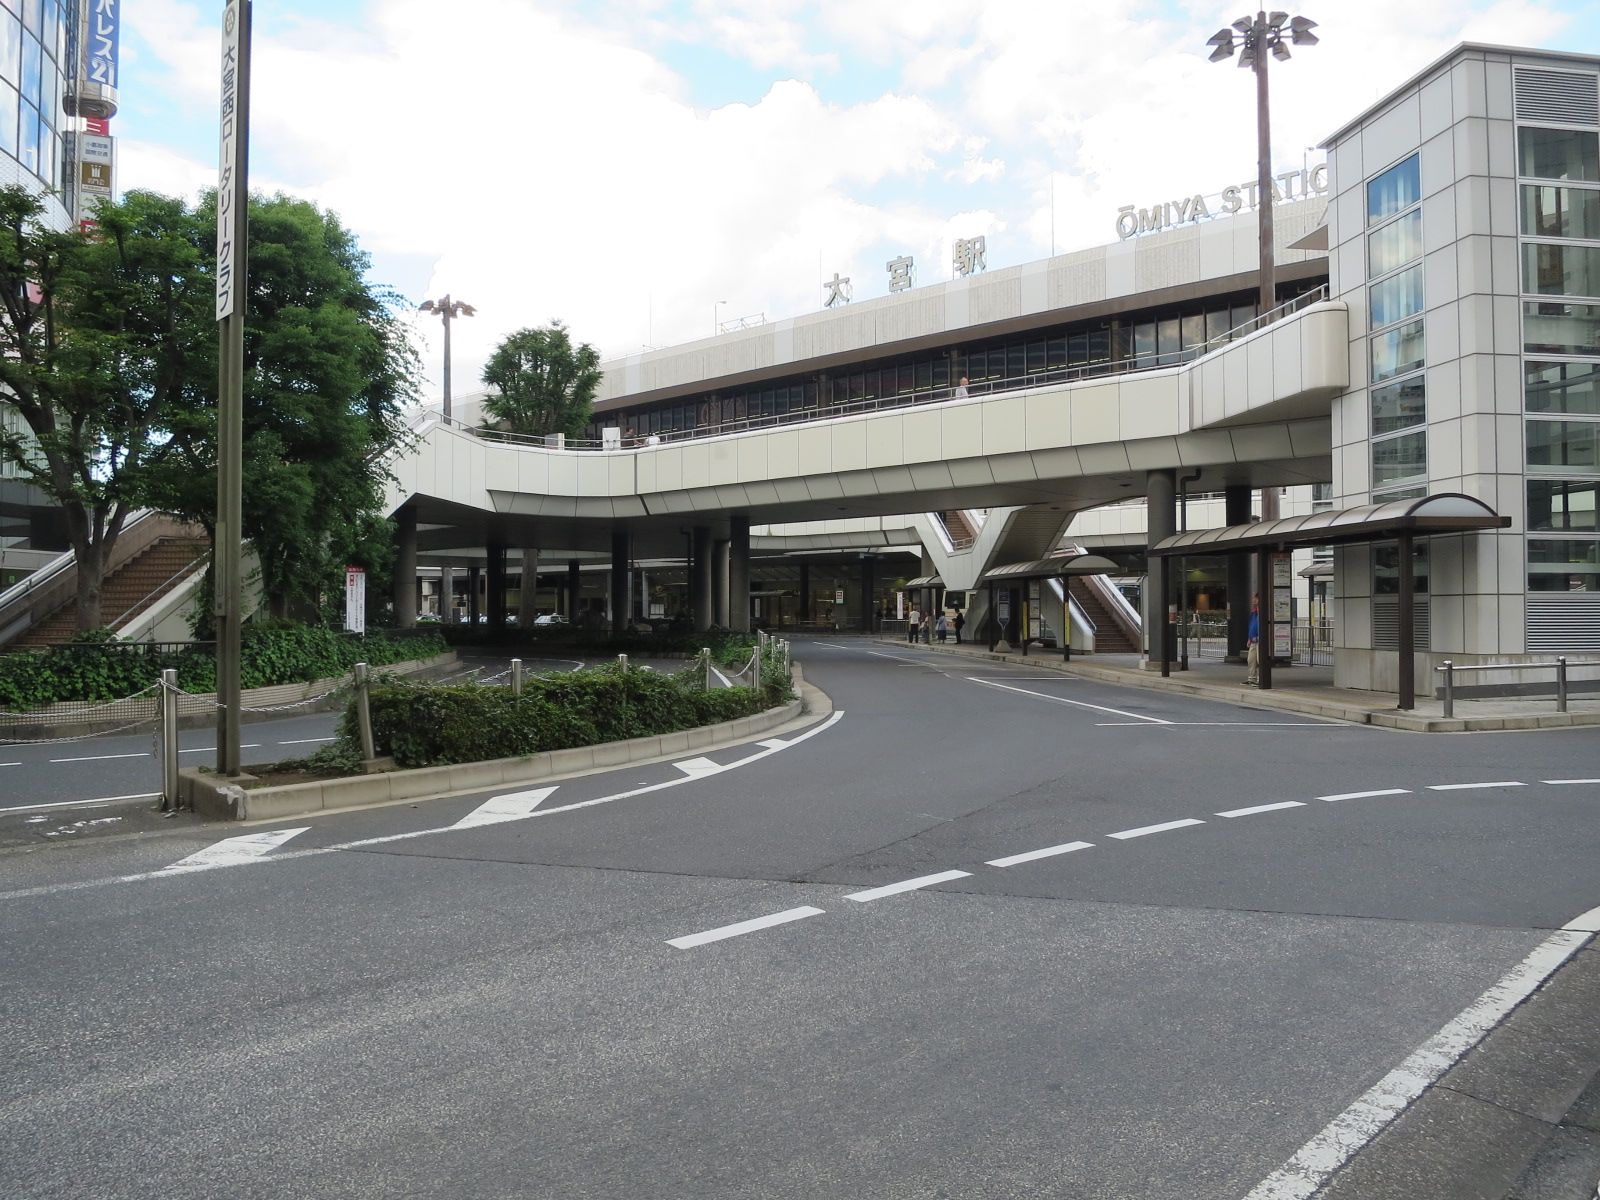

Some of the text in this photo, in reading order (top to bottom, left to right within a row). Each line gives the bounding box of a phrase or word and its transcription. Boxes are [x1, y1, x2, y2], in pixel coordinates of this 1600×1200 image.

[218, 45, 235, 312] 大宮西ロータリークラブ
[1116, 204, 1209, 238] ŌMIYA
[823, 235, 986, 307] 大宮駅
